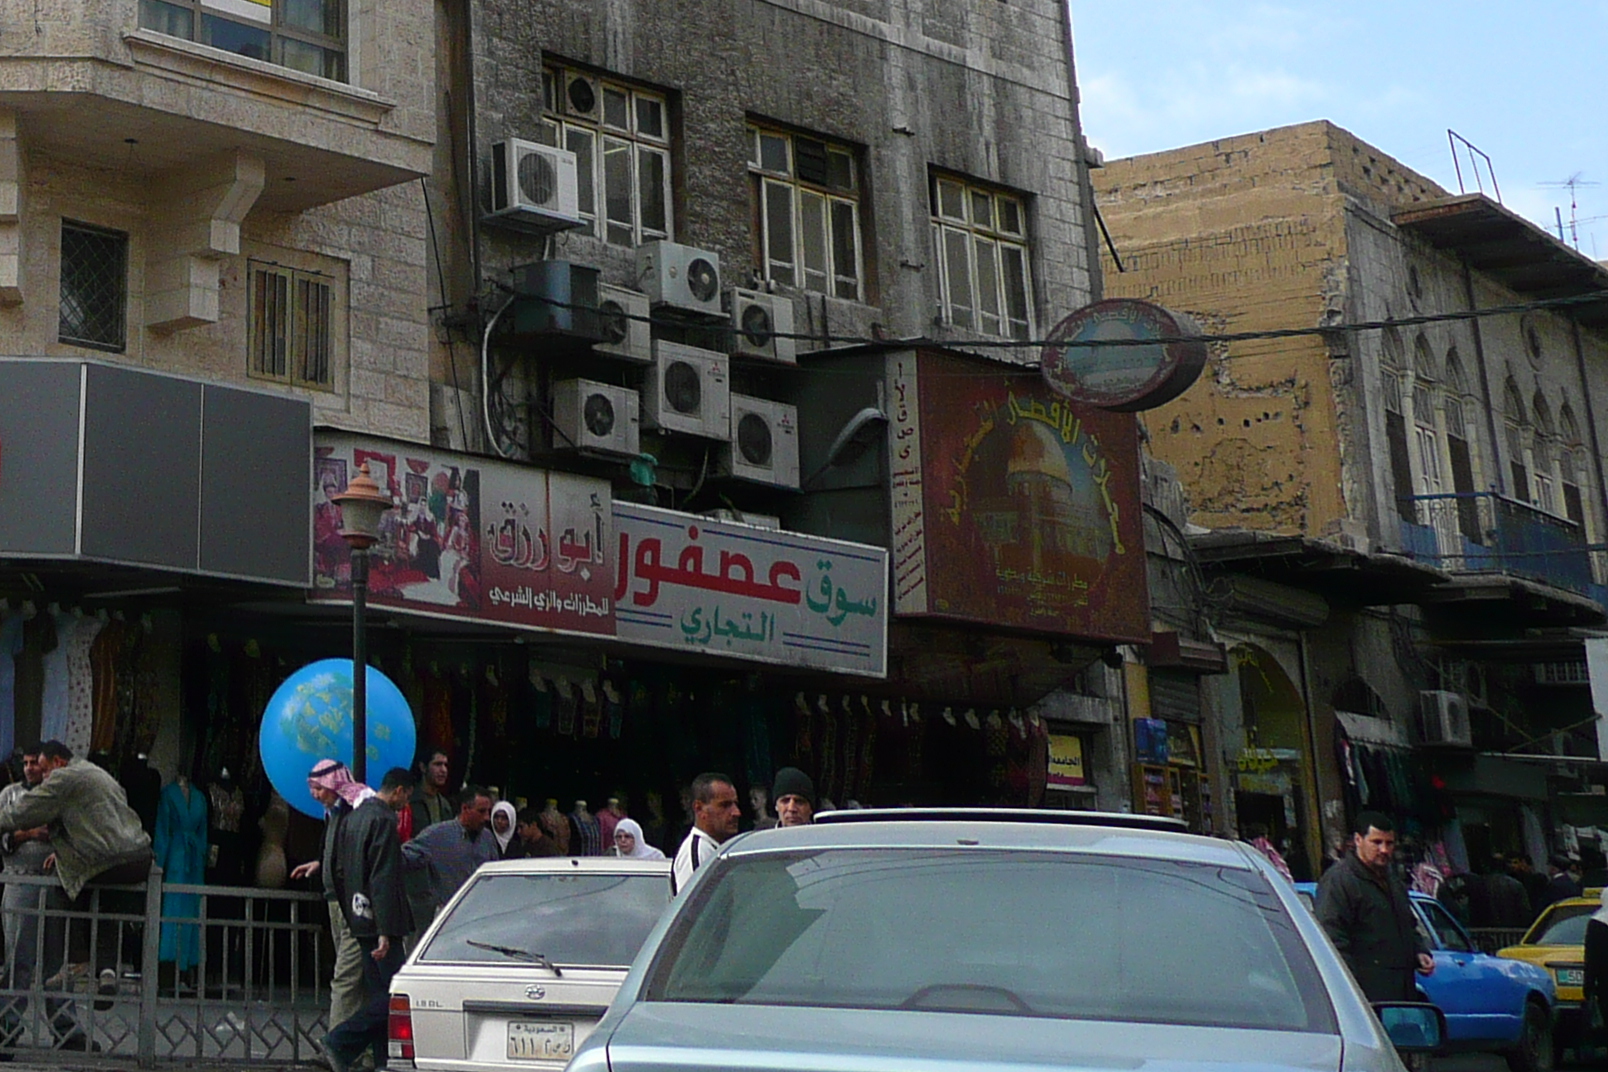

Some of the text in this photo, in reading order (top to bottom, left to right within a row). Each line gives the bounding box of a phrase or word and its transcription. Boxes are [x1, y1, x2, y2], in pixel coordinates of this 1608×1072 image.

[557, 493, 605, 582] أبو
[614, 525, 877, 627] سوق عصفور
[489, 586, 609, 617] للمطرزات والزي الشرعي
[680, 605, 775, 645] التجاري
[523, 1024, 558, 1034] السعودية
